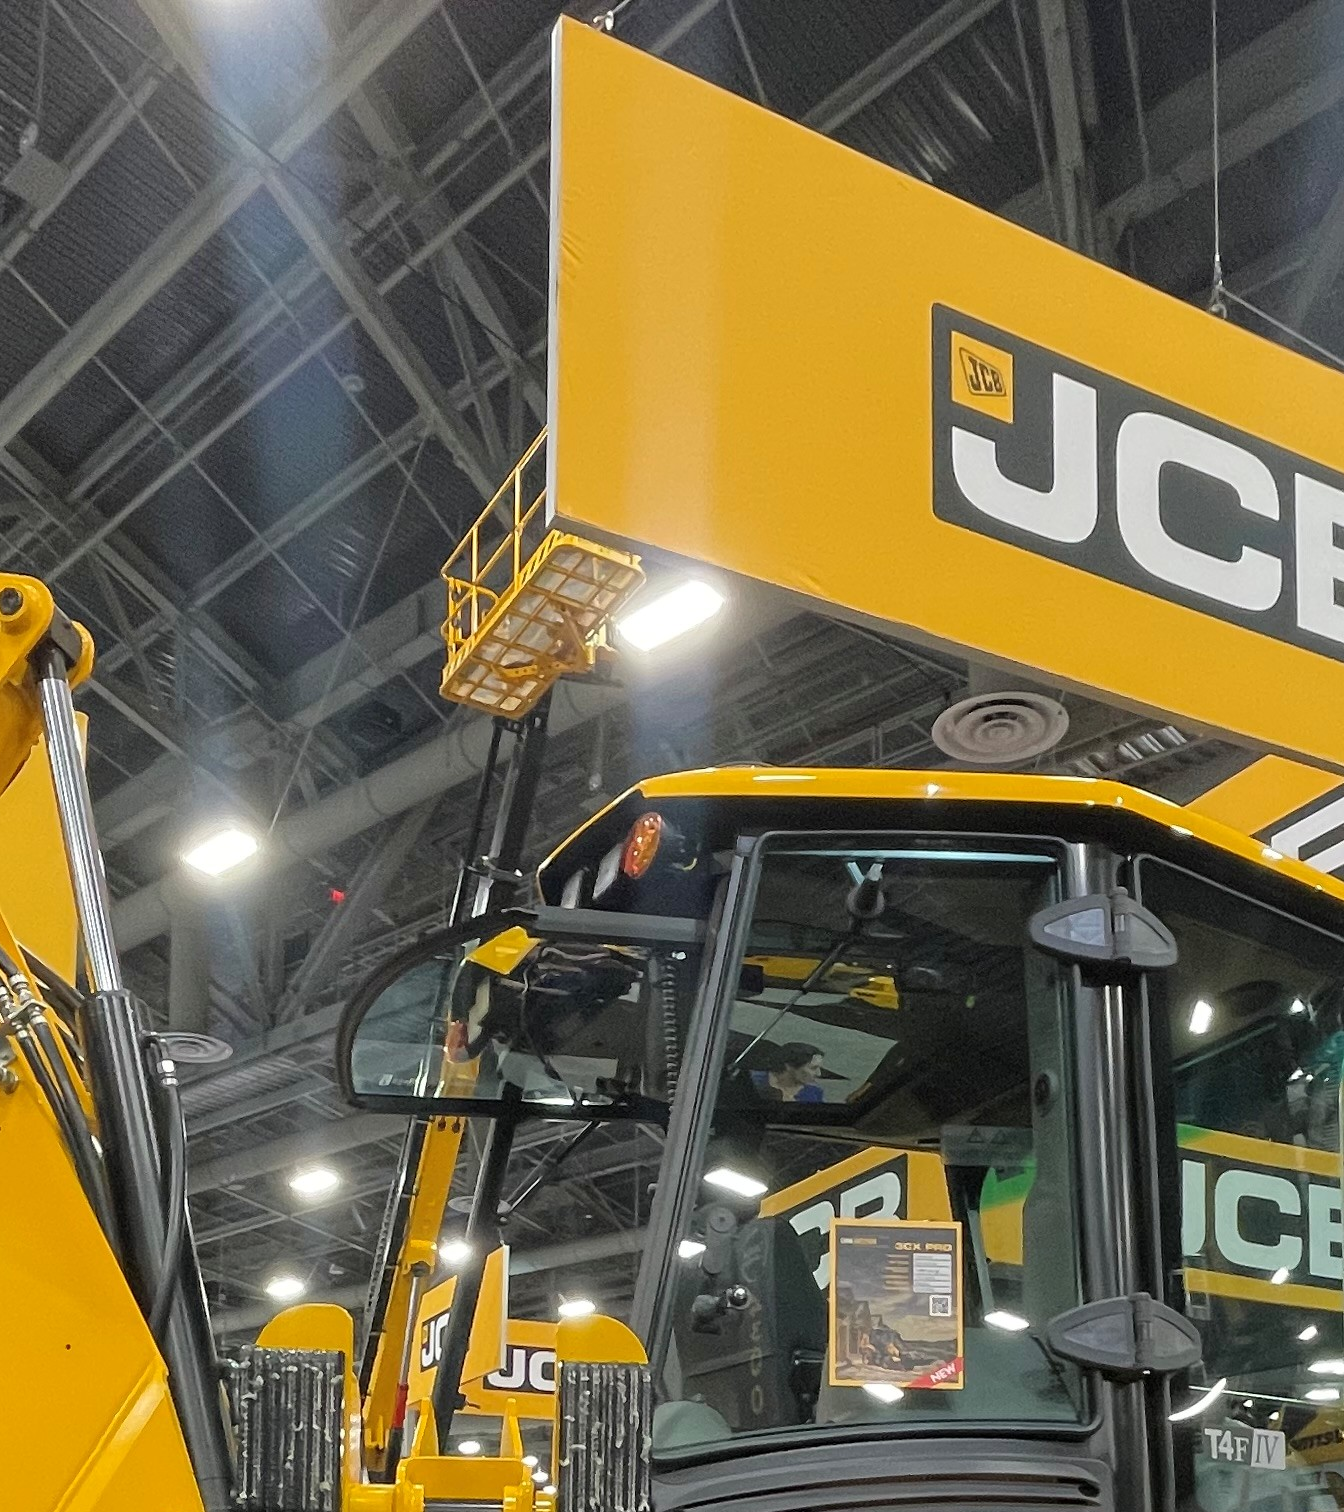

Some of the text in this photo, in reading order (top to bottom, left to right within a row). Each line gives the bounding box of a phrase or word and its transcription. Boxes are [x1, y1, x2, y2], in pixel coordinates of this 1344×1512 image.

[968, 356, 1004, 395] JCB
[422, 1313, 451, 1367] JC
[486, 1349, 556, 1391] JC
[930, 1362, 957, 1383] NEW
[1204, 1428, 1250, 1462] T4F
[1255, 1434, 1279, 1464] IV
